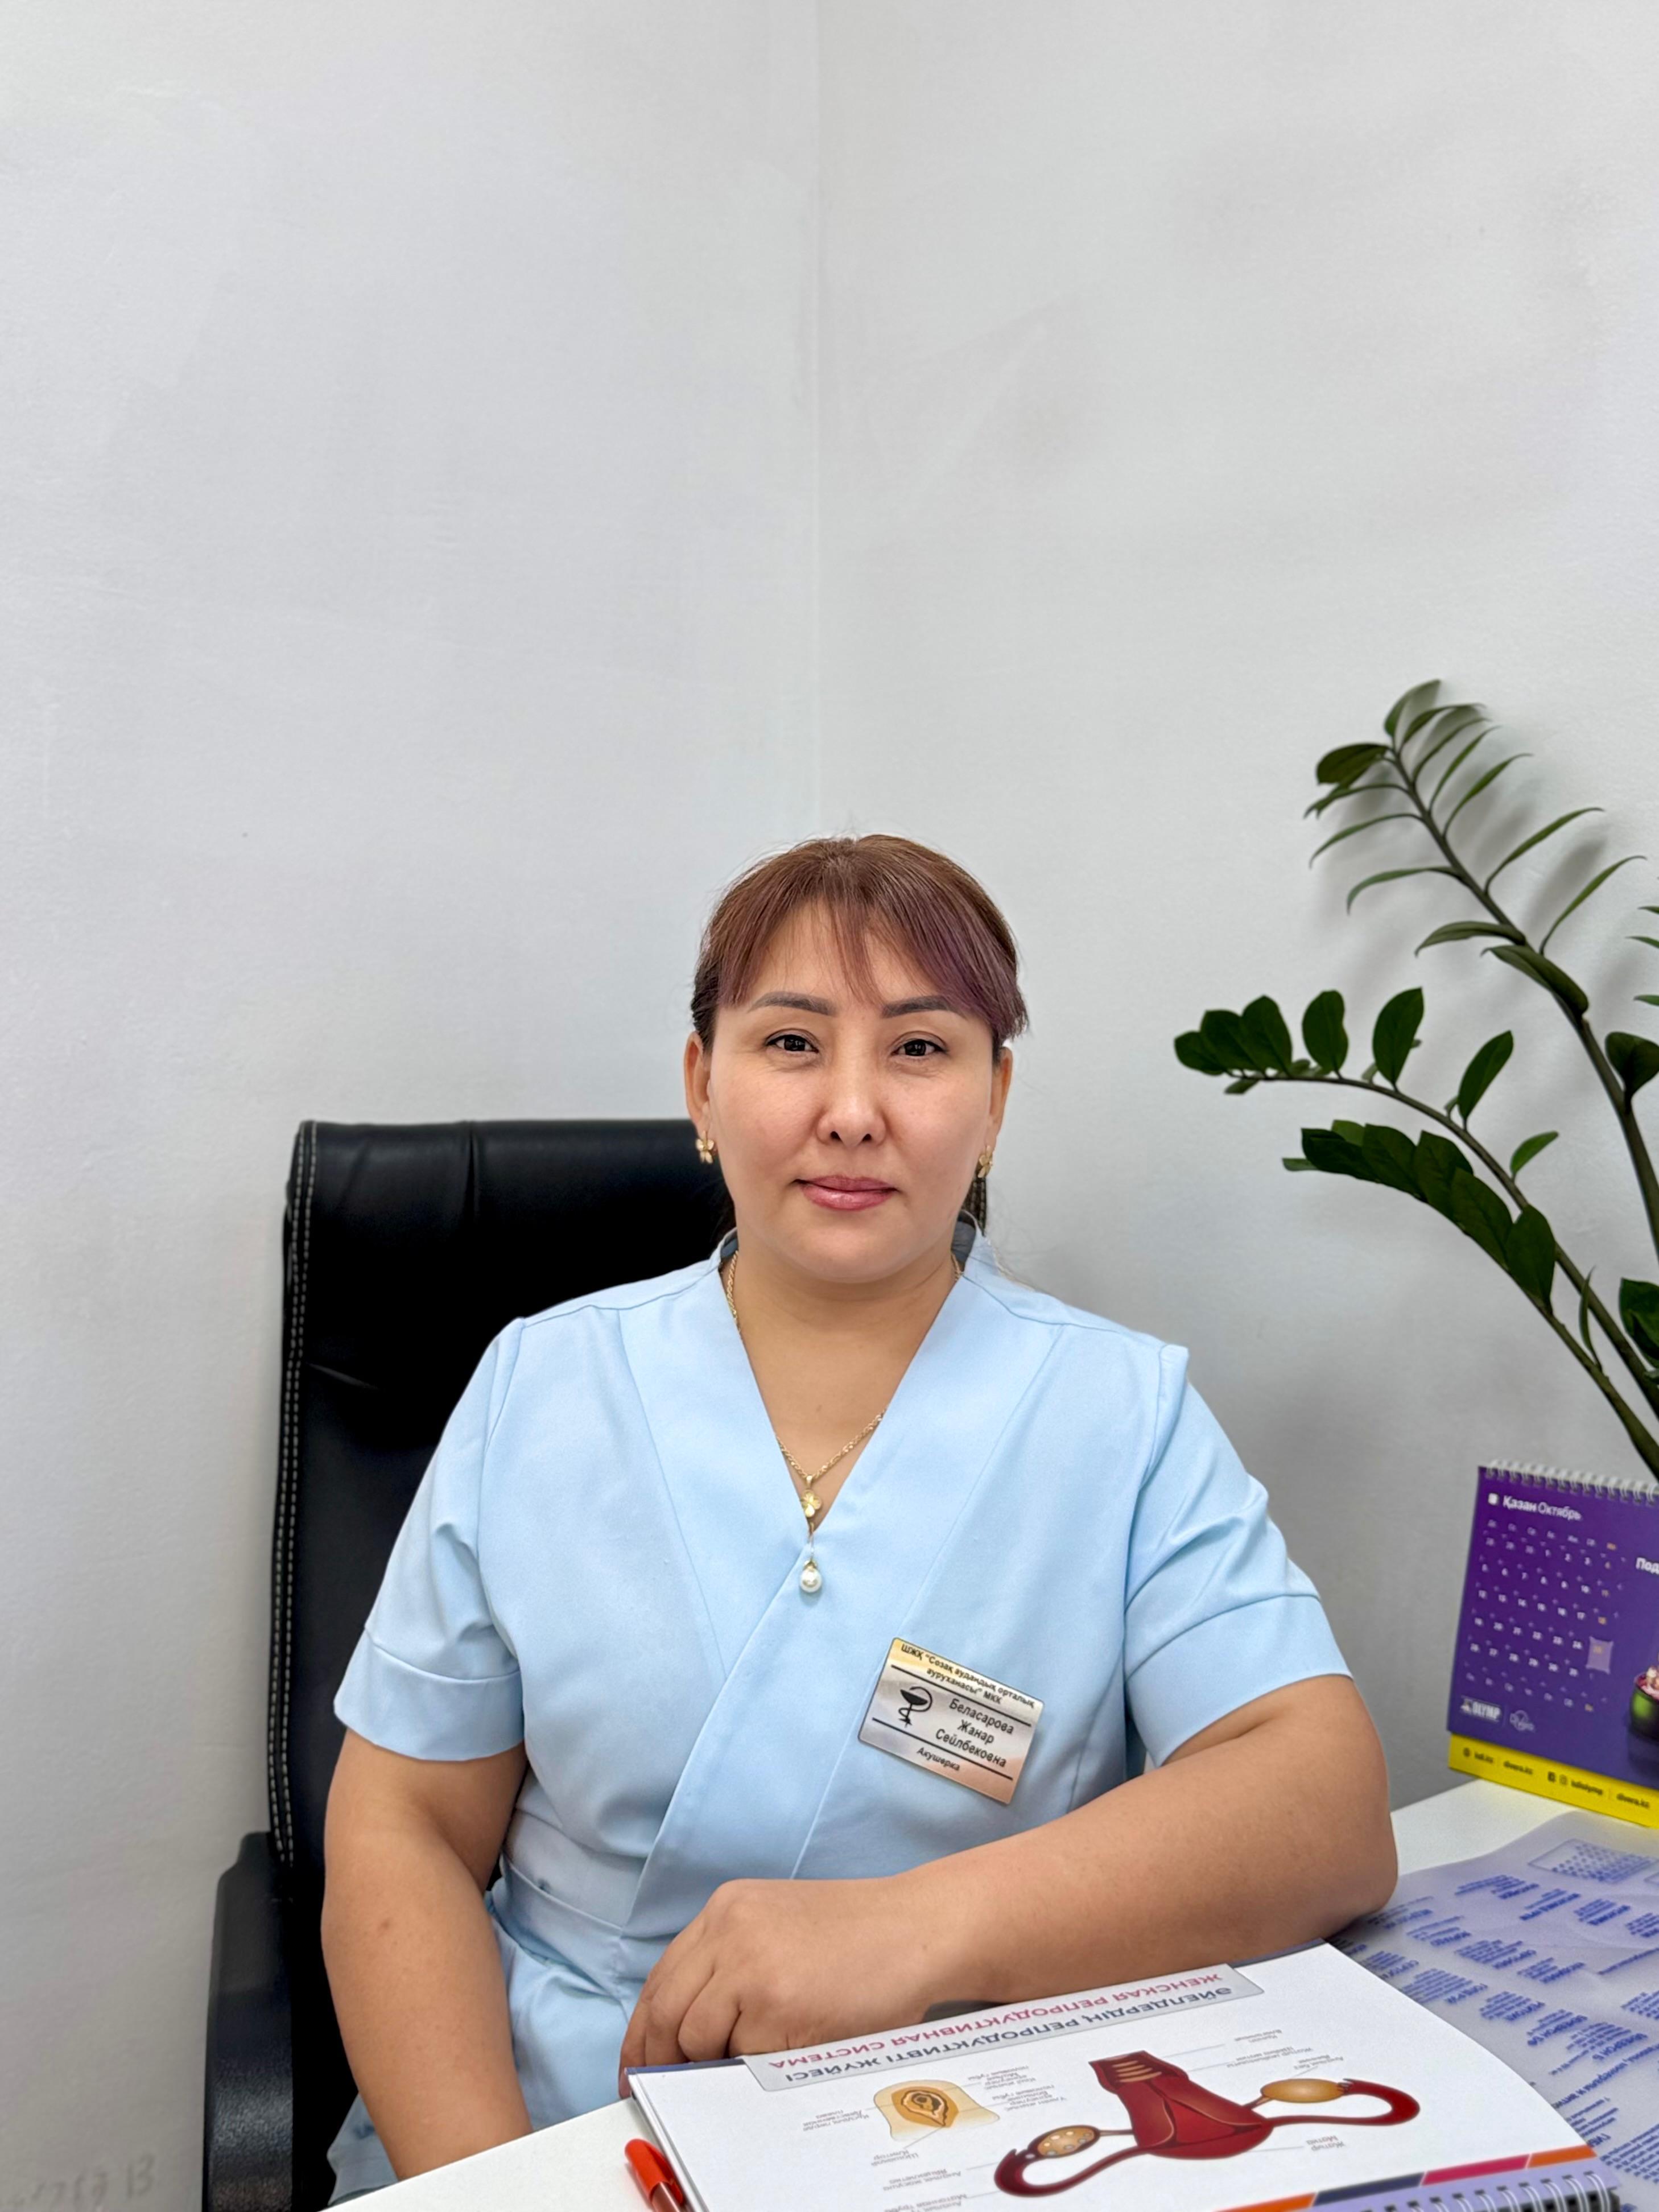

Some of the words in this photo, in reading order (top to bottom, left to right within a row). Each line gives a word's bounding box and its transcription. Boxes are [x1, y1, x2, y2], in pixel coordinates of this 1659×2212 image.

[1503, 1495, 1537, 1512] Қазан
[1538, 1502, 1582, 1521] Октябрь
[901, 1643, 924, 1661] ШЖҚ
[997, 1686, 1035, 1708] орталық
[983, 1691, 1002, 1705] МКК
[1472, 1701, 1501, 1719] OLYMP
[949, 1698, 1014, 1735] Беласарова
[958, 1720, 994, 1745] Жанар
[917, 1747, 960, 1771] Акушерка
[936, 1729, 1006, 1768] Сейлбековна
[1112, 1974, 1222, 2001] ЖЕНСКАЯ
[1081, 1988, 1231, 2023] ӘЙЕЛДЕРДІҢ
[891, 1997, 1108, 2046] РЕПРОДУКТИВНАЯ
[886, 2019, 1080, 2063] РЕПРОДУКТИВТІ
[769, 2042, 885, 2069] СИСТЕМА
[785, 2058, 881, 2081] ЖҮЙЕСІ
